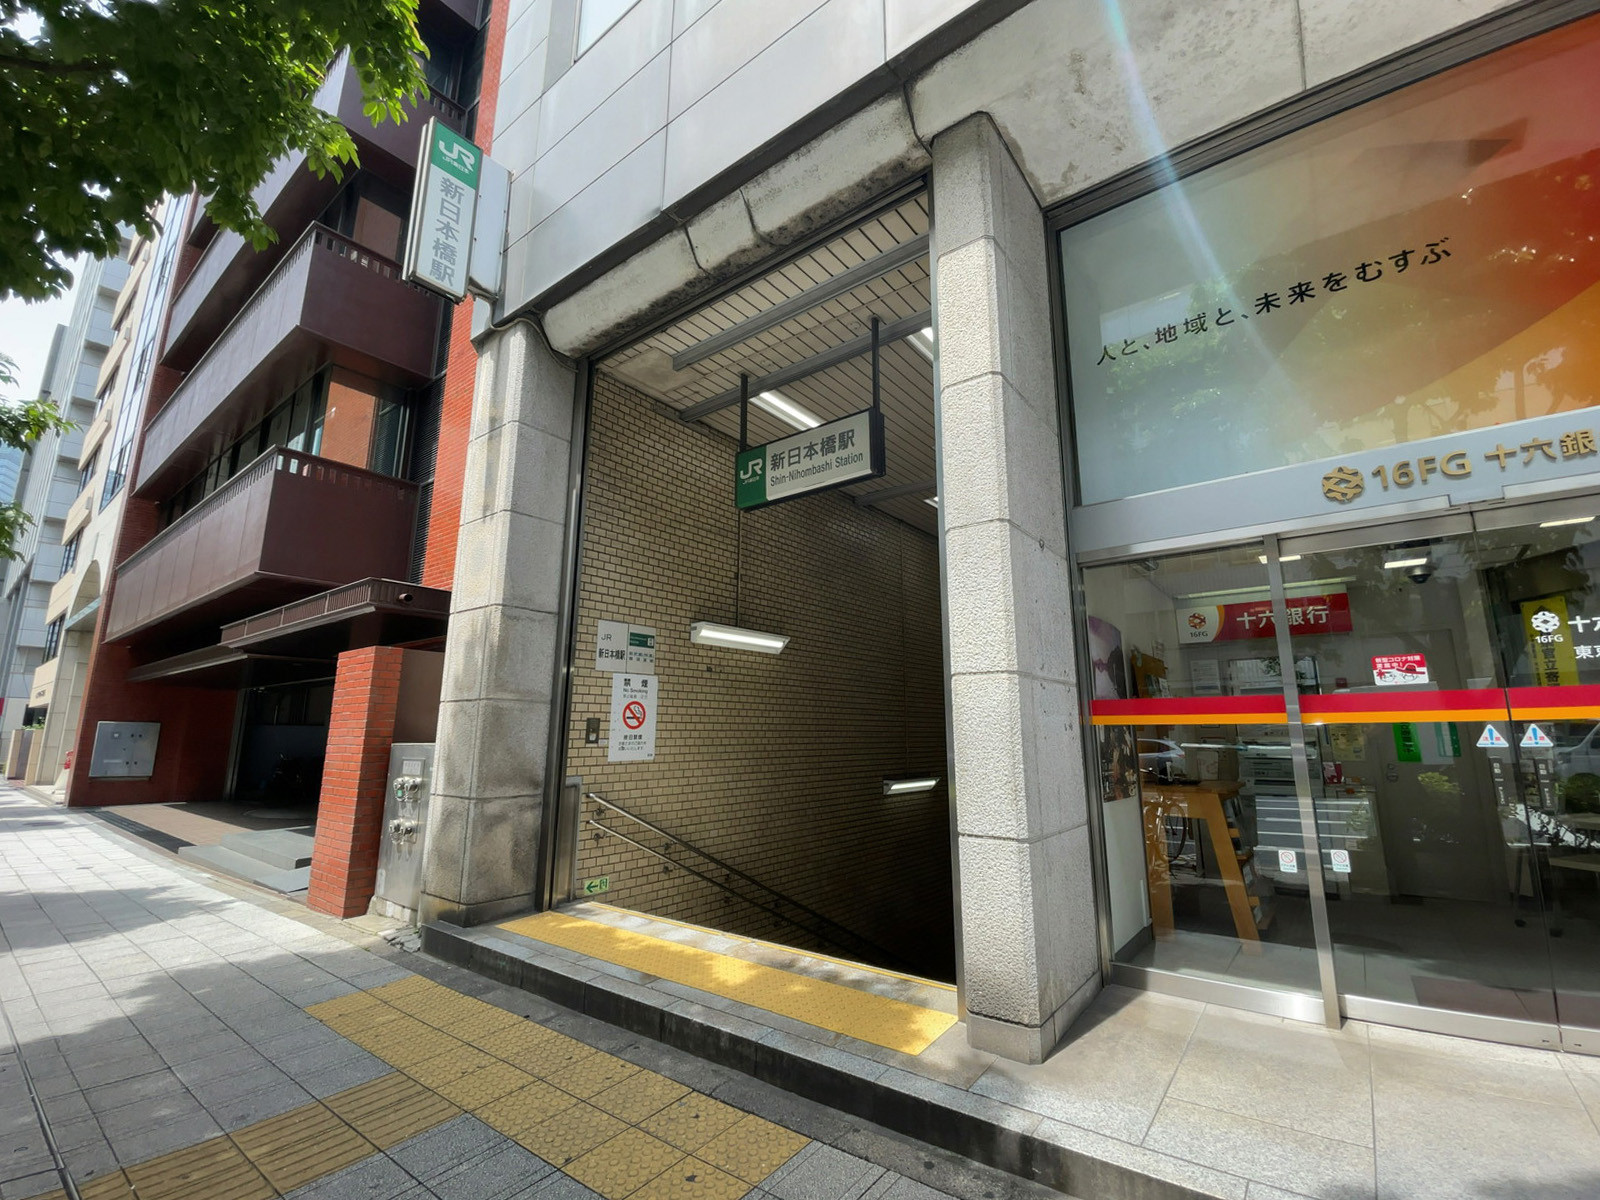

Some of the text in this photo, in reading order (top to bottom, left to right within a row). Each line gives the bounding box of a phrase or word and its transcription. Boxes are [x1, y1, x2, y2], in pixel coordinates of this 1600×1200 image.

[438, 139, 474, 172] JR
[429, 176, 465, 288] 新日本橋駅
[1097, 237, 1452, 366] 人と、地域と、未来をむすぶ
[770, 429, 855, 472] 新日本橋駅
[1371, 427, 1600, 490] 16FG 十六銀
[740, 458, 763, 480] JR
[770, 452, 864, 487] Shin-Nihombashi Station
[598, 648, 626, 660] 新日本橋駅
[601, 633, 612, 642] JR
[1535, 634, 1564, 643] 16FG
